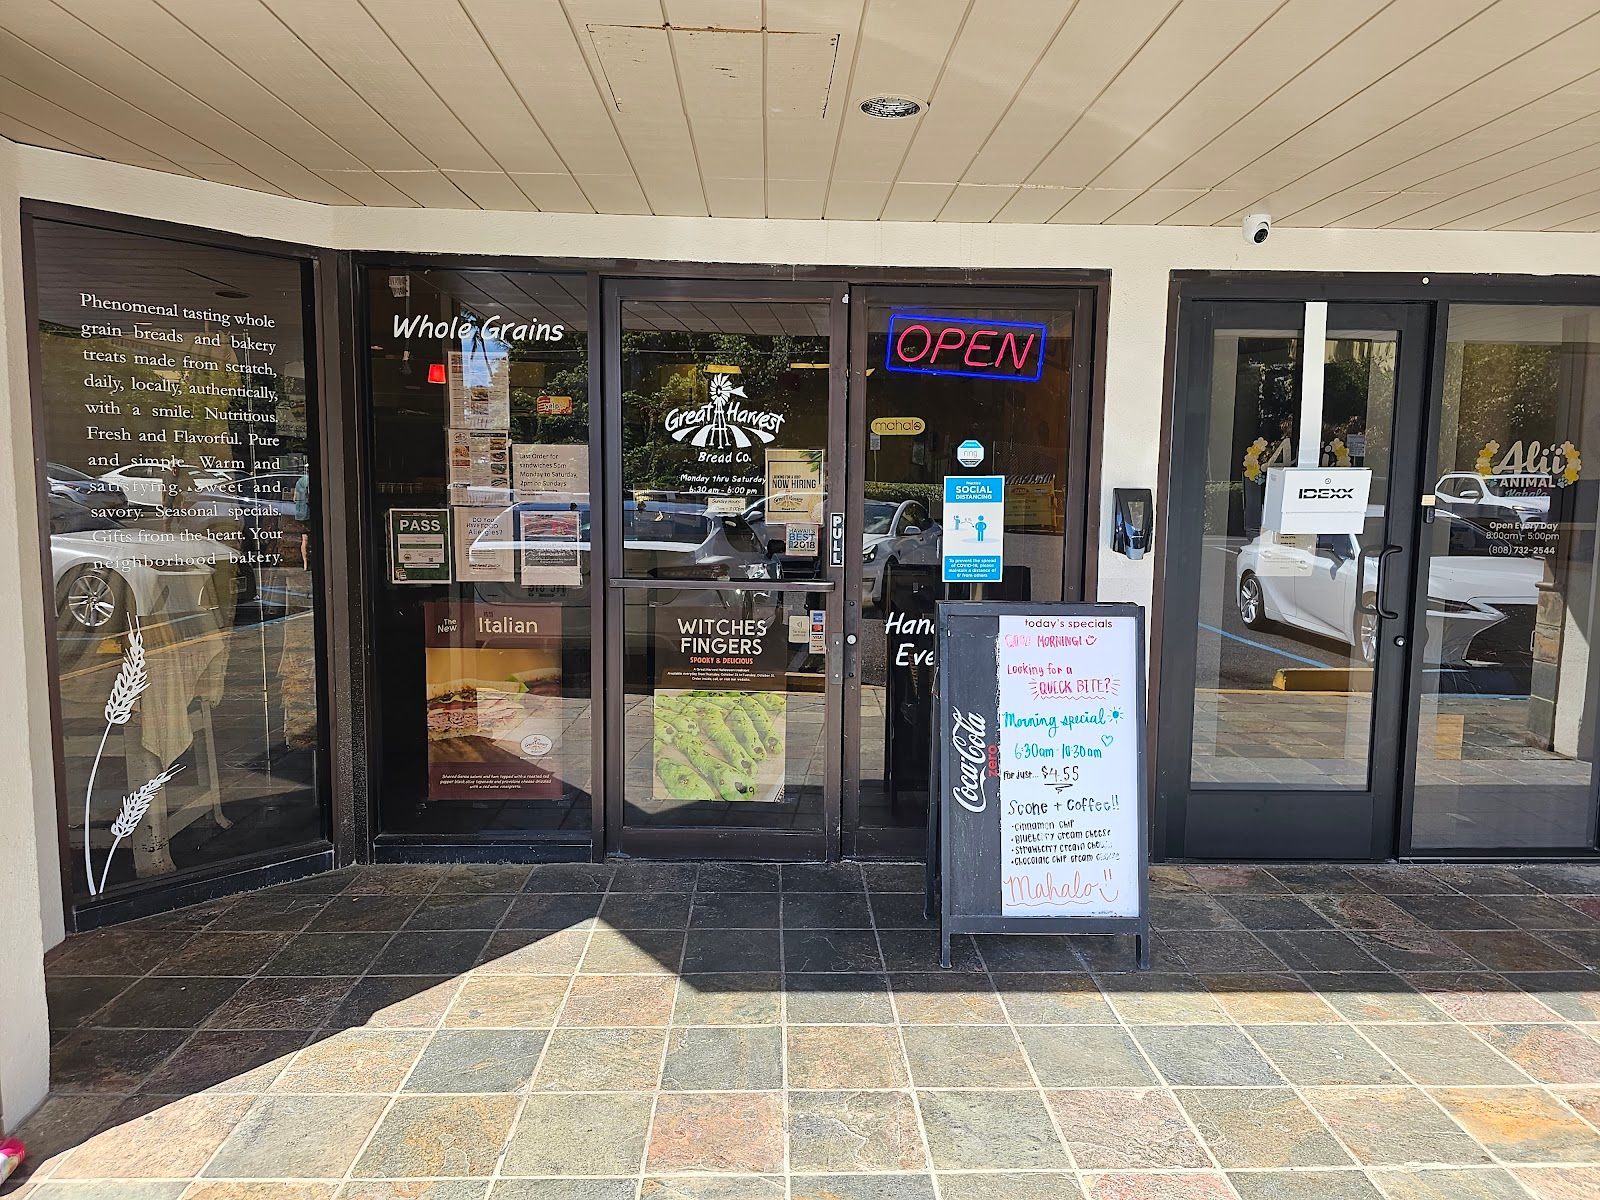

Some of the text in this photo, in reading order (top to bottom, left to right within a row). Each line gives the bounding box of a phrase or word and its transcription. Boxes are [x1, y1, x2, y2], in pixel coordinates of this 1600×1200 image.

[80, 293, 276, 328] Phenomenal tasting whole
[393, 314, 565, 342] Whole Grains
[80, 322, 276, 356] grain breads and bakery
[897, 324, 1035, 370] OPEN
[83, 349, 277, 379] treats made from scratch,
[84, 374, 279, 403] daily, locally, authentically,
[84, 400, 278, 423] with a smile. Nutritious.
[665, 402, 785, 434] Great Harvest
[875, 420, 922, 431] mahalo
[86, 426, 280, 447] Fresh and Flavorful. Pure
[87, 453, 120, 467] and
[199, 456, 245, 470] Warm
[254, 457, 281, 470] and
[698, 451, 752, 463] Bread Co.
[963, 450, 978, 458] ring
[253, 481, 282, 494] and
[680, 474, 766, 485] Monday thru Saturday
[772, 480, 817, 489] NOW HIRING
[1500, 478, 1556, 488] ANIMAL
[727, 486, 744, 494] 6:00
[1298, 488, 1354, 499] IDEXX
[90, 503, 282, 521] savory. Seasonal specials.
[400, 519, 441, 531] PASS
[1490, 522, 1559, 531] Open Every Day
[92, 527, 284, 545] Gifts from the heart. Your
[789, 533, 816, 541] BEST
[833, 516, 843, 564] PULL
[1486, 532, 1518, 540] 8:00am
[1527, 533, 1560, 541] 5:00pm
[1488, 545, 1555, 555] (808) 732-2544
[93, 550, 284, 573] neighborhood bakery.
[437, 625, 458, 634] New
[479, 616, 538, 633] Italian
[677, 618, 767, 637] WITCHES
[1025, 619, 1113, 629] today's specials
[681, 637, 763, 655] FINGERS
[722, 657, 753, 665] DELICIOUS
[1007, 663, 1044, 676] Looking
[1047, 662, 1063, 674] for
[1077, 677, 1111, 693] BITE?
[1002, 708, 1106, 738] Morning special
[988, 744, 998, 777] zero
[1008, 799, 1048, 816] Scone
[1054, 802, 1061, 811] +
